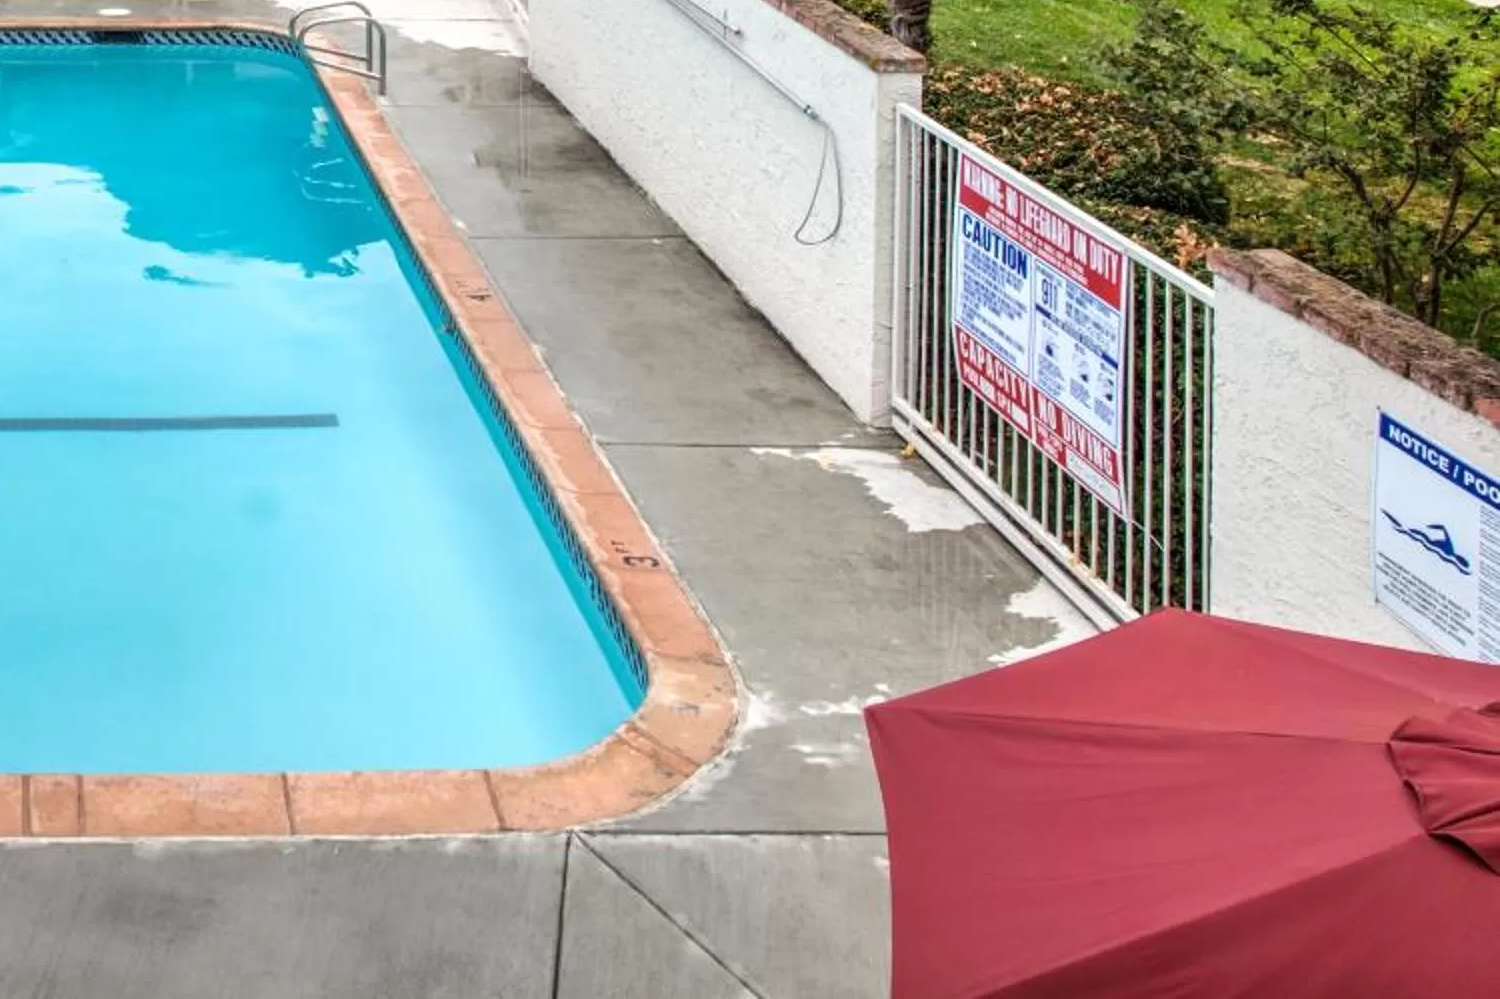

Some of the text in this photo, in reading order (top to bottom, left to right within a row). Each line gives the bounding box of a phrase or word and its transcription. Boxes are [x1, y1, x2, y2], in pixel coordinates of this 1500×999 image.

[963, 213, 1027, 279] CAUTION
[1089, 237, 1120, 285] DUTY
[1042, 278, 1059, 314] 911
[959, 331, 1028, 409] CAPACITY
[1037, 389, 1057, 431] NO
[1061, 410, 1114, 475] DIVING
[1389, 424, 1449, 474] NOTICE
[1463, 469, 1500, 504] POO
